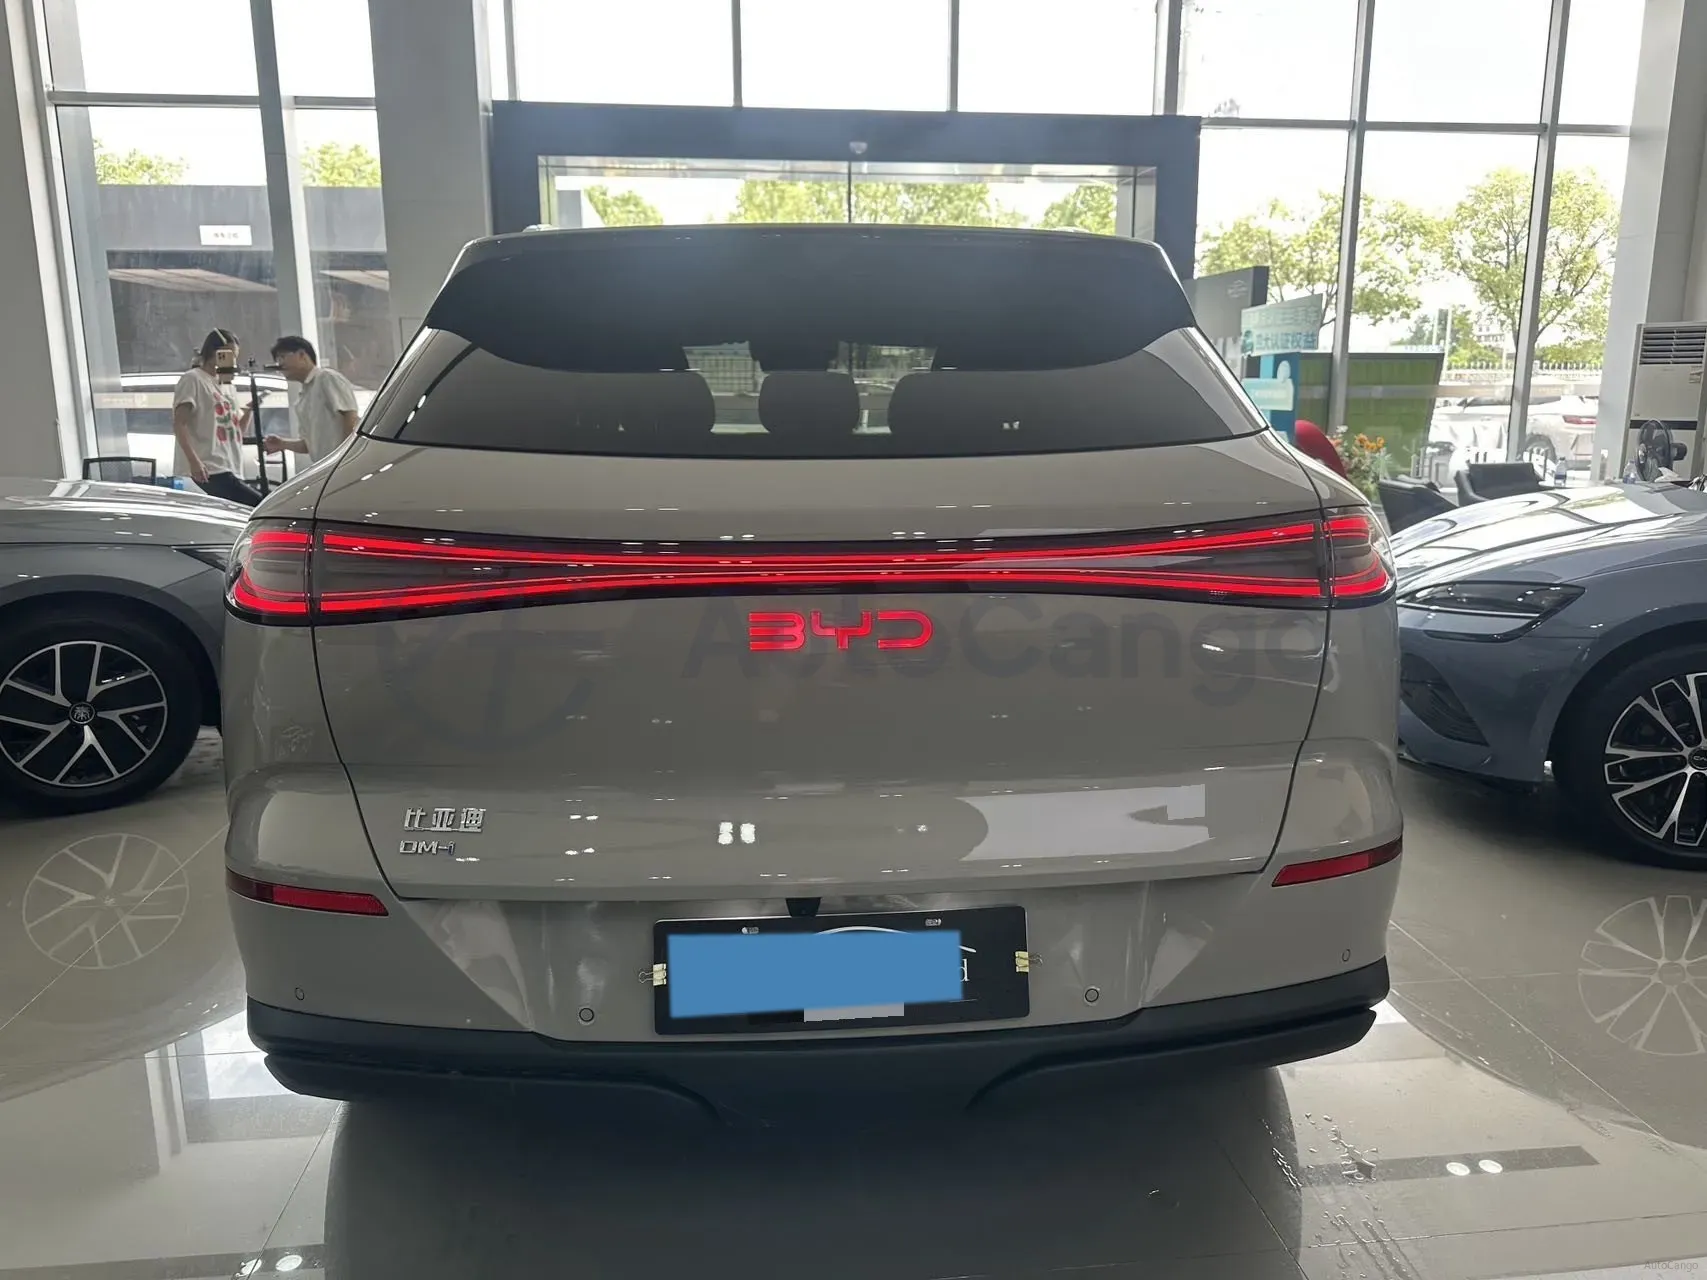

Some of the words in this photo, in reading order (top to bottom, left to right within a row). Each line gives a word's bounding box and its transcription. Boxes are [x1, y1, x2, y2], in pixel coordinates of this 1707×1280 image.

[748, 611, 934, 650] BYD
[403, 807, 487, 833] 比亚迪
[399, 840, 456, 856] DM-i
